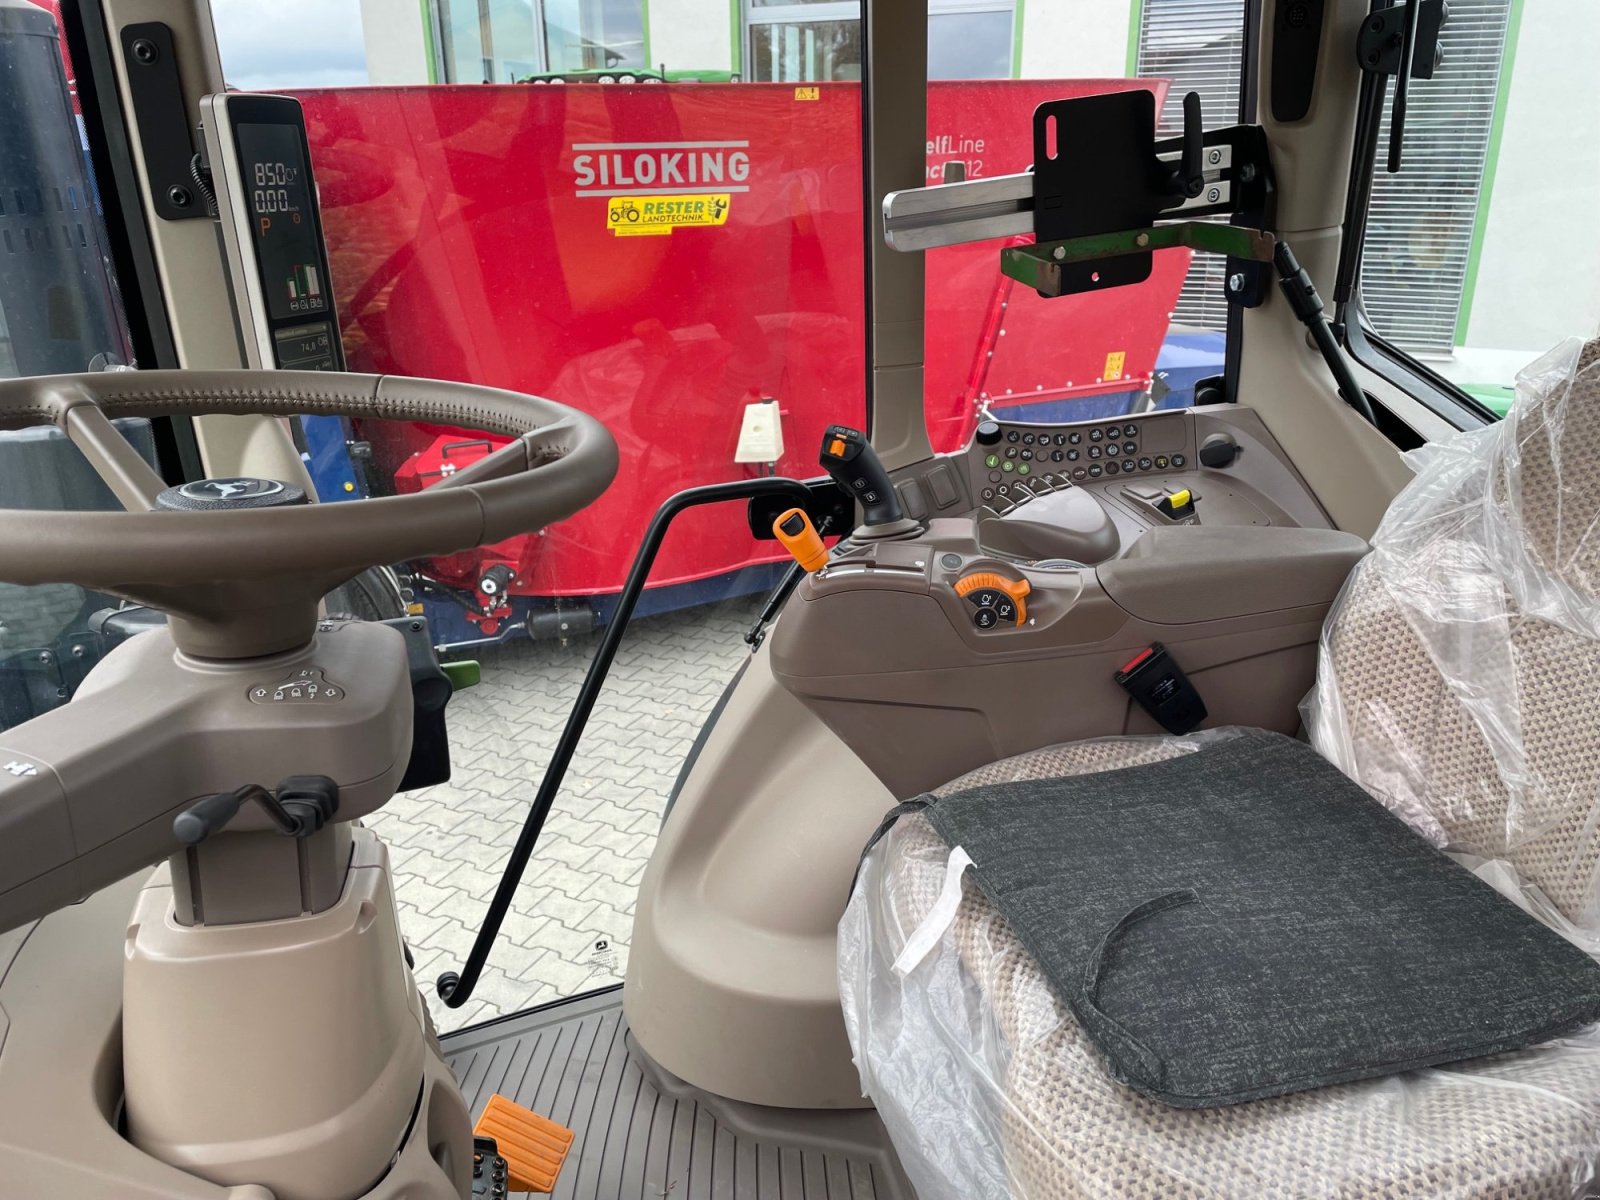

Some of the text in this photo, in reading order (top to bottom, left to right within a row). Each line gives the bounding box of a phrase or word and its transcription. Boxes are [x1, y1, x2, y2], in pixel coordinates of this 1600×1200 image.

[926, 135, 985, 154] elfLine
[254, 163, 287, 186] 850
[573, 151, 750, 186] SILOKING
[643, 201, 705, 215] RESTER
[642, 213, 704, 223] LANDTECHNIK
